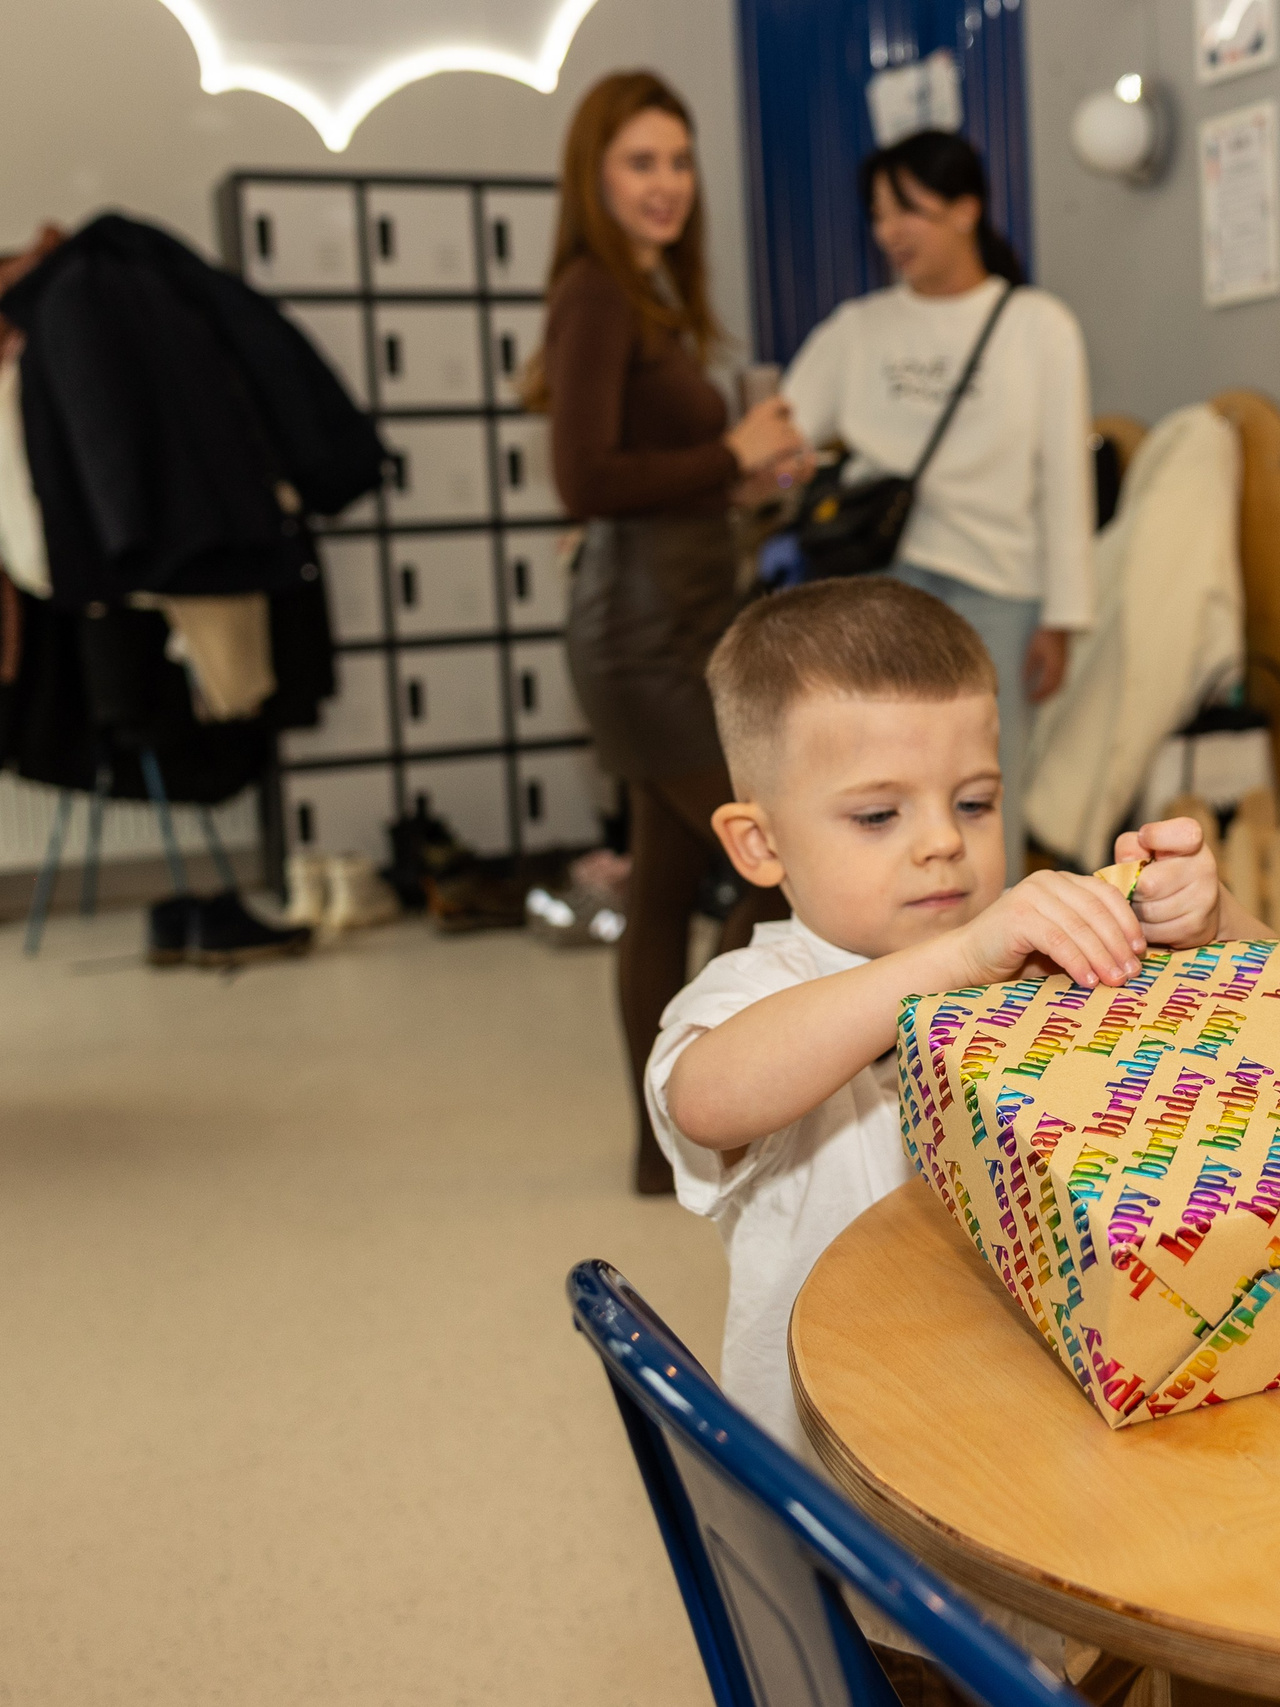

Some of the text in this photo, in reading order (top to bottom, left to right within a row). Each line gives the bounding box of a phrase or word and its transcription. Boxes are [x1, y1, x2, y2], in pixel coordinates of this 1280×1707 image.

[959, 1030, 1007, 1150] happy
[1001, 1011, 1082, 1080] happy
[1081, 1033, 1176, 1139] birthday
[1026, 1111, 1084, 1312] birthday
[1072, 992, 1149, 1058] happy
[1121, 1065, 1216, 1181] birthday
[995, 1084, 1053, 1288] birthday
[1066, 1142, 1119, 1276] happy
[1155, 1154, 1243, 1268] happy
